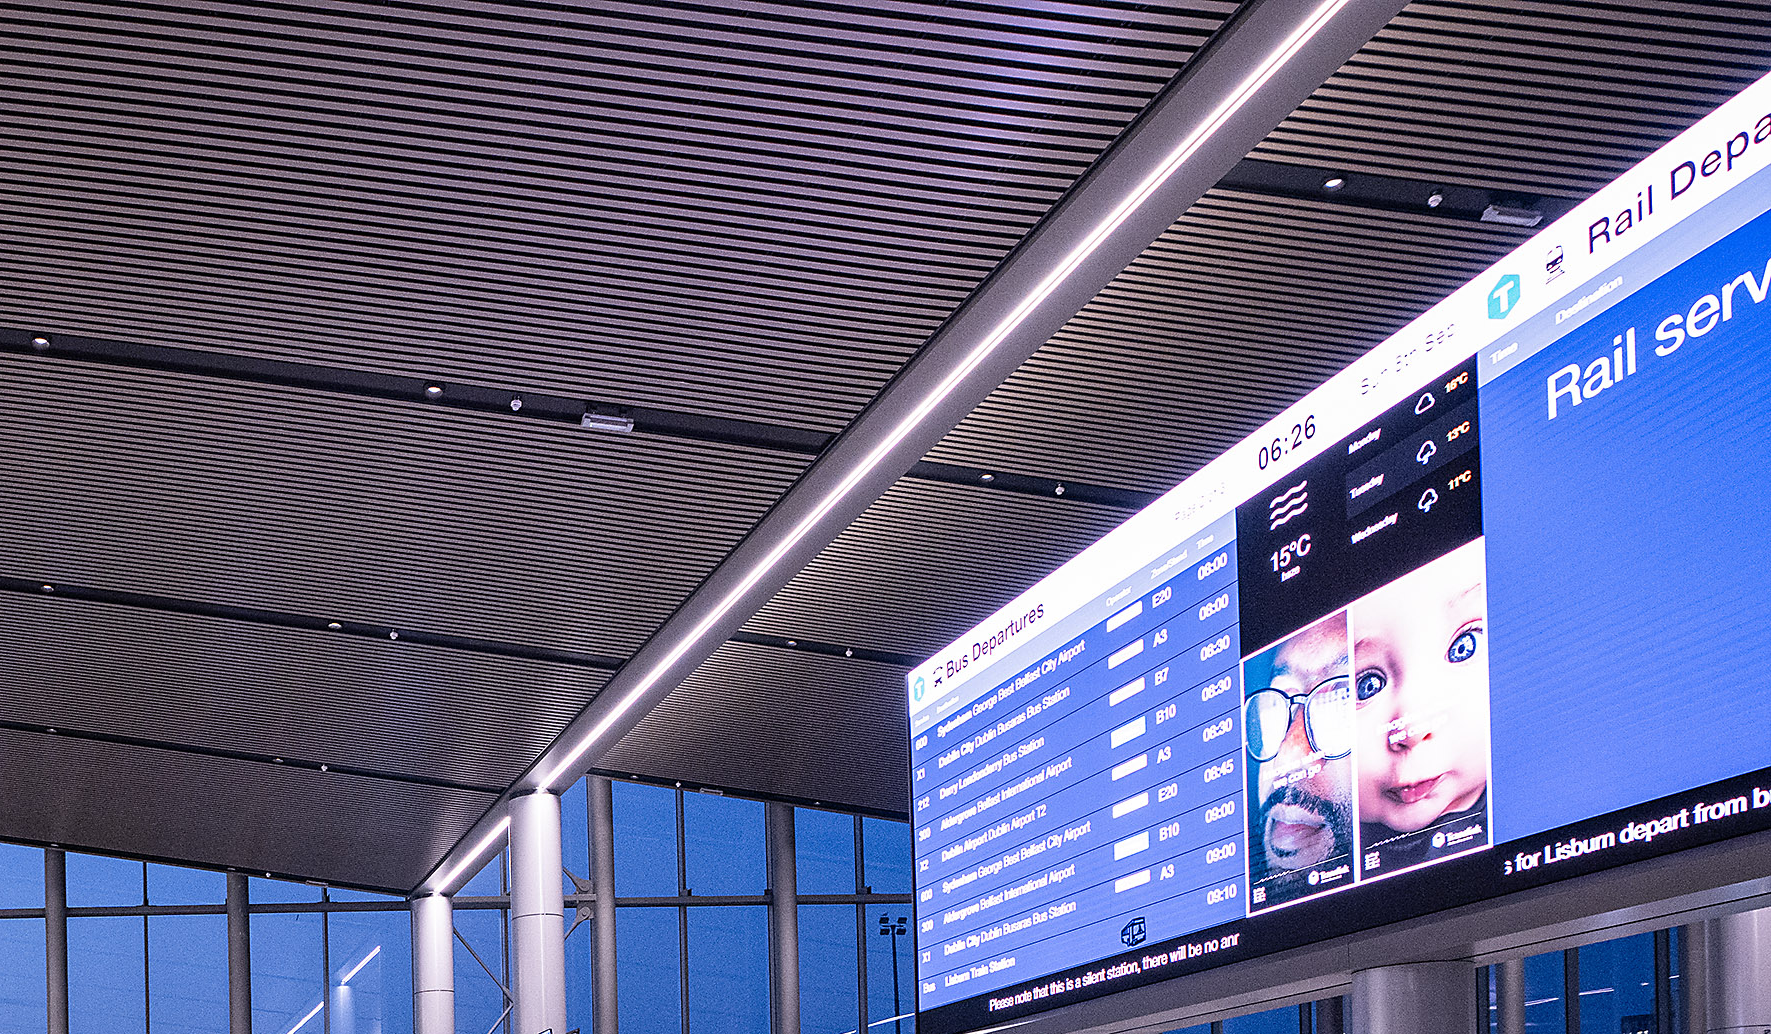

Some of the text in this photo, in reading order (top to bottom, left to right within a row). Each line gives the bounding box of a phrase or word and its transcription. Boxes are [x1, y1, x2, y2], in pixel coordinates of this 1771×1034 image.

[1589, 185, 1653, 254] Rail
[1554, 276, 1624, 326] Destination
[1546, 326, 1637, 421] Rail
[1258, 414, 1317, 471] 06:26
[1348, 428, 1381, 455] Monday
[1349, 473, 1384, 499] Tuesday
[1269, 533, 1312, 572] 15°C
[1350, 512, 1399, 544] Wednesday
[946, 603, 1045, 679] Bus Departures
[972, 695, 998, 717] George
[997, 682, 1015, 702] Best
[1014, 667, 1042, 691] Belfast
[1041, 657, 1058, 675] City
[1057, 639, 1086, 666] Airport
[1152, 586, 1172, 609] E20
[1197, 552, 1228, 581] 08:00
[960, 740, 975, 757] City
[974, 728, 997, 749] Dublin
[996, 711, 1027, 736] Busaras
[1026, 701, 1042, 720] Bus
[1042, 686, 1071, 710] Station
[1153, 628, 1168, 647] A3
[1198, 593, 1229, 621] 08:00
[1002, 751, 1018, 767] Bus
[1018, 736, 1045, 759] Station
[1154, 666, 1170, 686] B7
[1200, 634, 1230, 661] 08:30
[977, 792, 1001, 813] Belfast
[1001, 769, 1045, 801] International
[1045, 756, 1073, 780] Airport
[1156, 703, 1177, 724] B10
[1201, 675, 1232, 702] 08:30
[1307, 763, 1321, 779] go
[963, 831, 989, 855] Airport
[988, 822, 1011, 841] Dublin
[1010, 809, 1036, 831] Airport
[1035, 803, 1047, 819] T2
[1156, 745, 1172, 764] A3
[1202, 717, 1233, 742] 08:30
[978, 859, 1003, 879] George
[1002, 851, 1020, 867] Best
[1020, 839, 1047, 861] Belfast
[1046, 833, 1063, 849] City
[1063, 820, 1092, 842] Airport
[1158, 783, 1179, 803] E20
[1203, 758, 1234, 783] 08:45
[979, 892, 1004, 911] Belfast
[1004, 873, 1048, 901] International
[1048, 864, 1076, 885] Airport
[1159, 822, 1180, 841] B10
[1204, 800, 1235, 824] 09:00
[1515, 851, 1541, 872] for
[1544, 831, 1615, 865] Lisburn
[1618, 808, 1690, 843] depart
[1692, 795, 1748, 825] from
[943, 940, 966, 956] Dublin
[966, 934, 981, 948] City
[980, 926, 1003, 943] Dublin
[1002, 916, 1032, 936] Busaras
[1032, 910, 1048, 925] Bus
[1048, 901, 1077, 919] Station
[1159, 863, 1175, 881] A3
[1206, 841, 1236, 865] 09:00
[989, 956, 1016, 973] Station
[1207, 883, 1237, 906] 09:10
[989, 939, 1219, 1012] Please note that this is a silent station, there will be no
